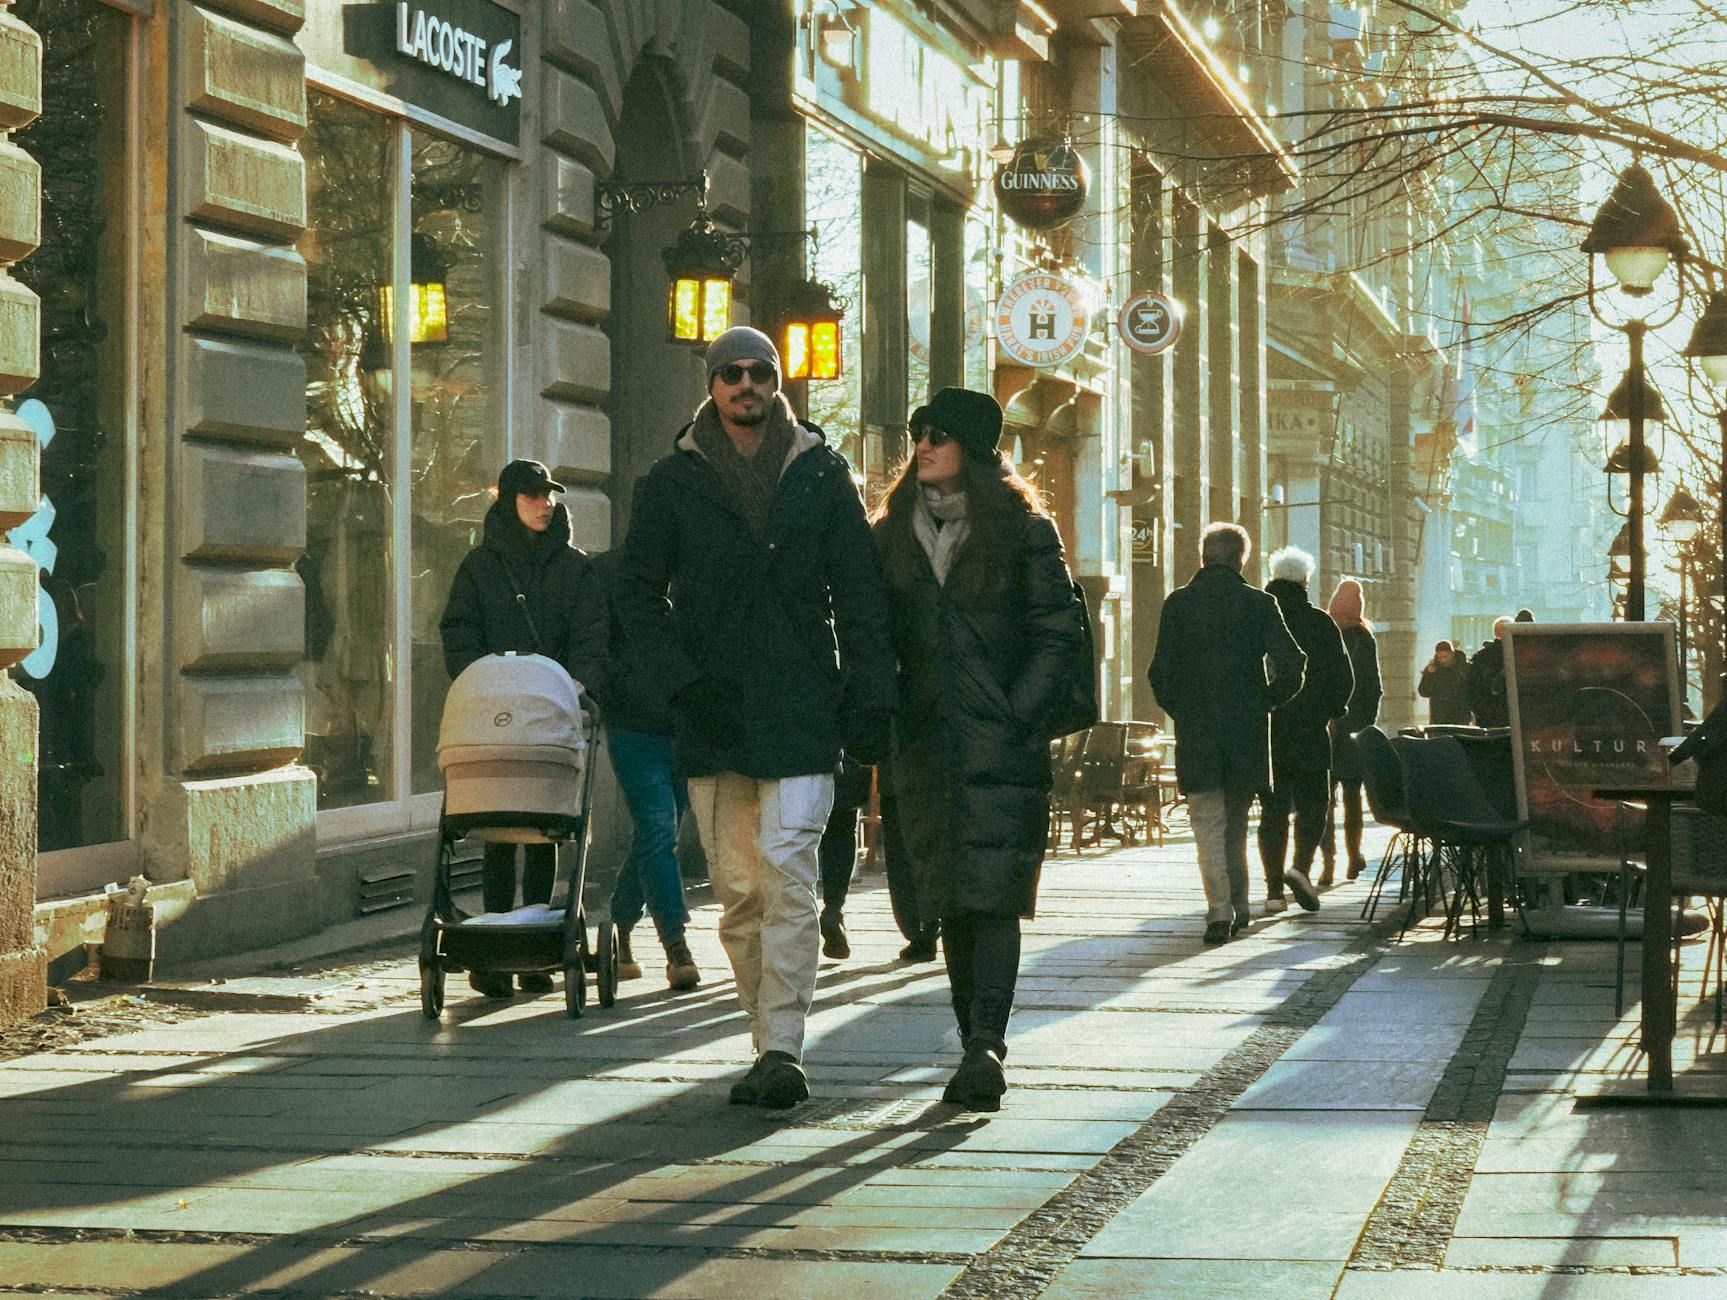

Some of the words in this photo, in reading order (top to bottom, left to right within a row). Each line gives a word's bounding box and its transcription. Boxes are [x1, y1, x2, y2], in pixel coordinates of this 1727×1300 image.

[396, 1, 486, 88] LACOSTE
[1000, 170, 1079, 190] GUINNESS
[1530, 739, 1647, 753] KULTUR
